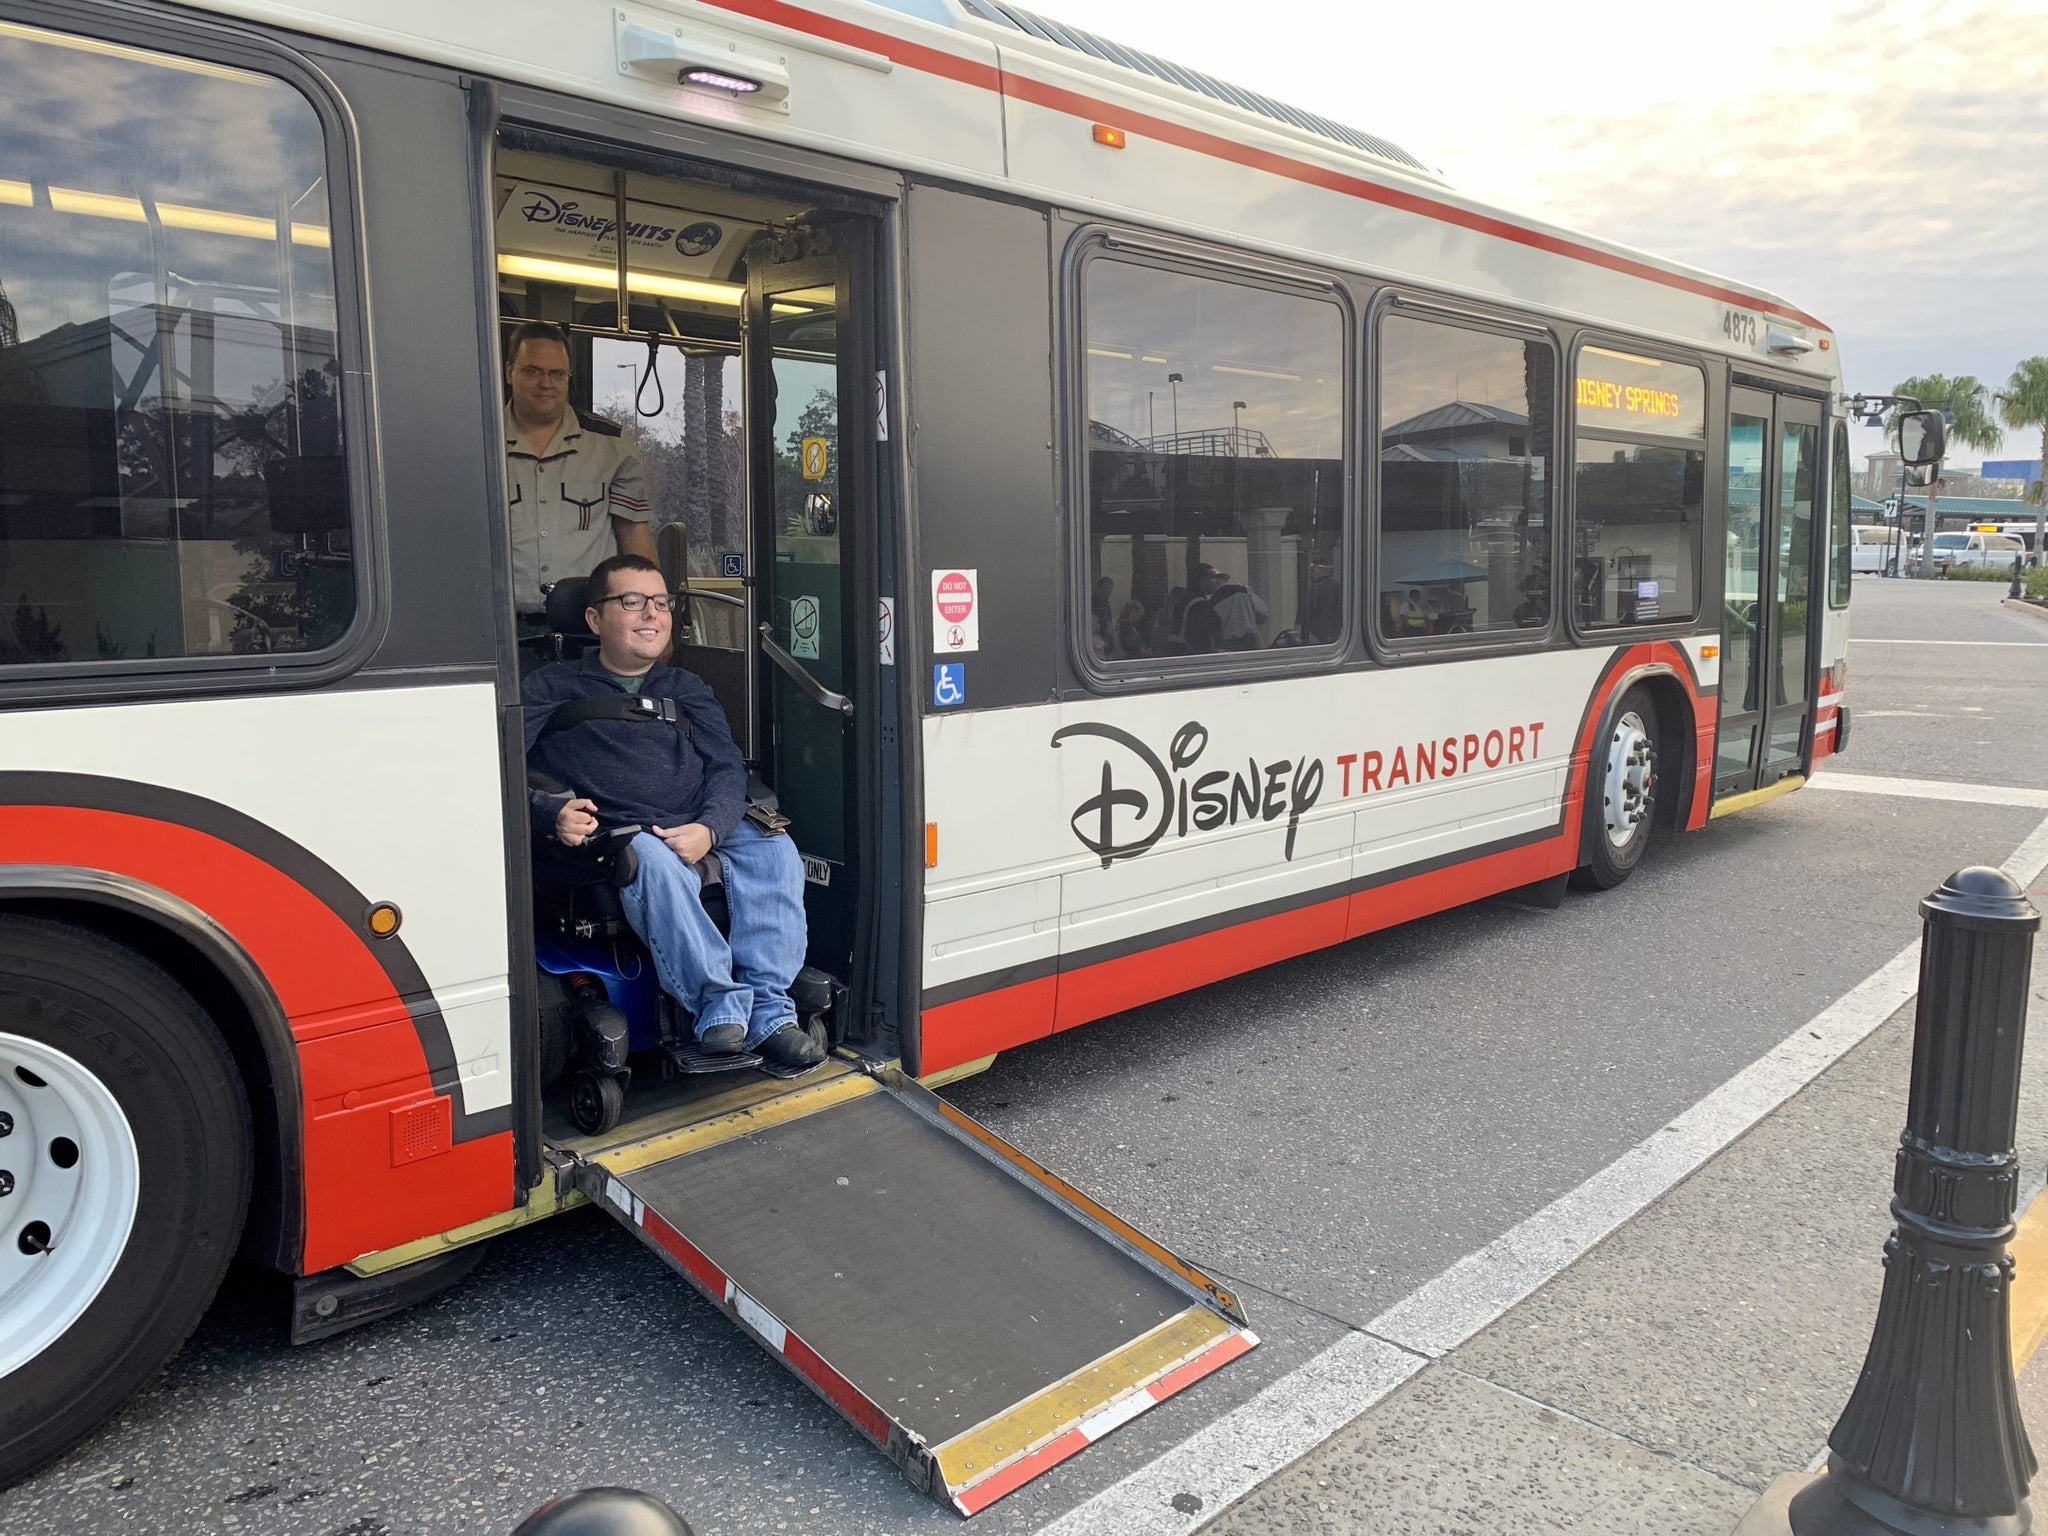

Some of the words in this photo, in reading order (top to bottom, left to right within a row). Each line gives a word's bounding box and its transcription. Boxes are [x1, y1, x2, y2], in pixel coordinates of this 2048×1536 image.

[626, 221, 676, 241] HITS
[1723, 310, 1756, 346] 4873
[1625, 385, 1680, 417] SPRINGS
[942, 582, 952, 591] DO
[954, 581, 967, 590] NOT
[944, 605, 967, 614] ENTER
[1337, 722, 1545, 797] TRANSPORT
[807, 860, 829, 881] ONLY
